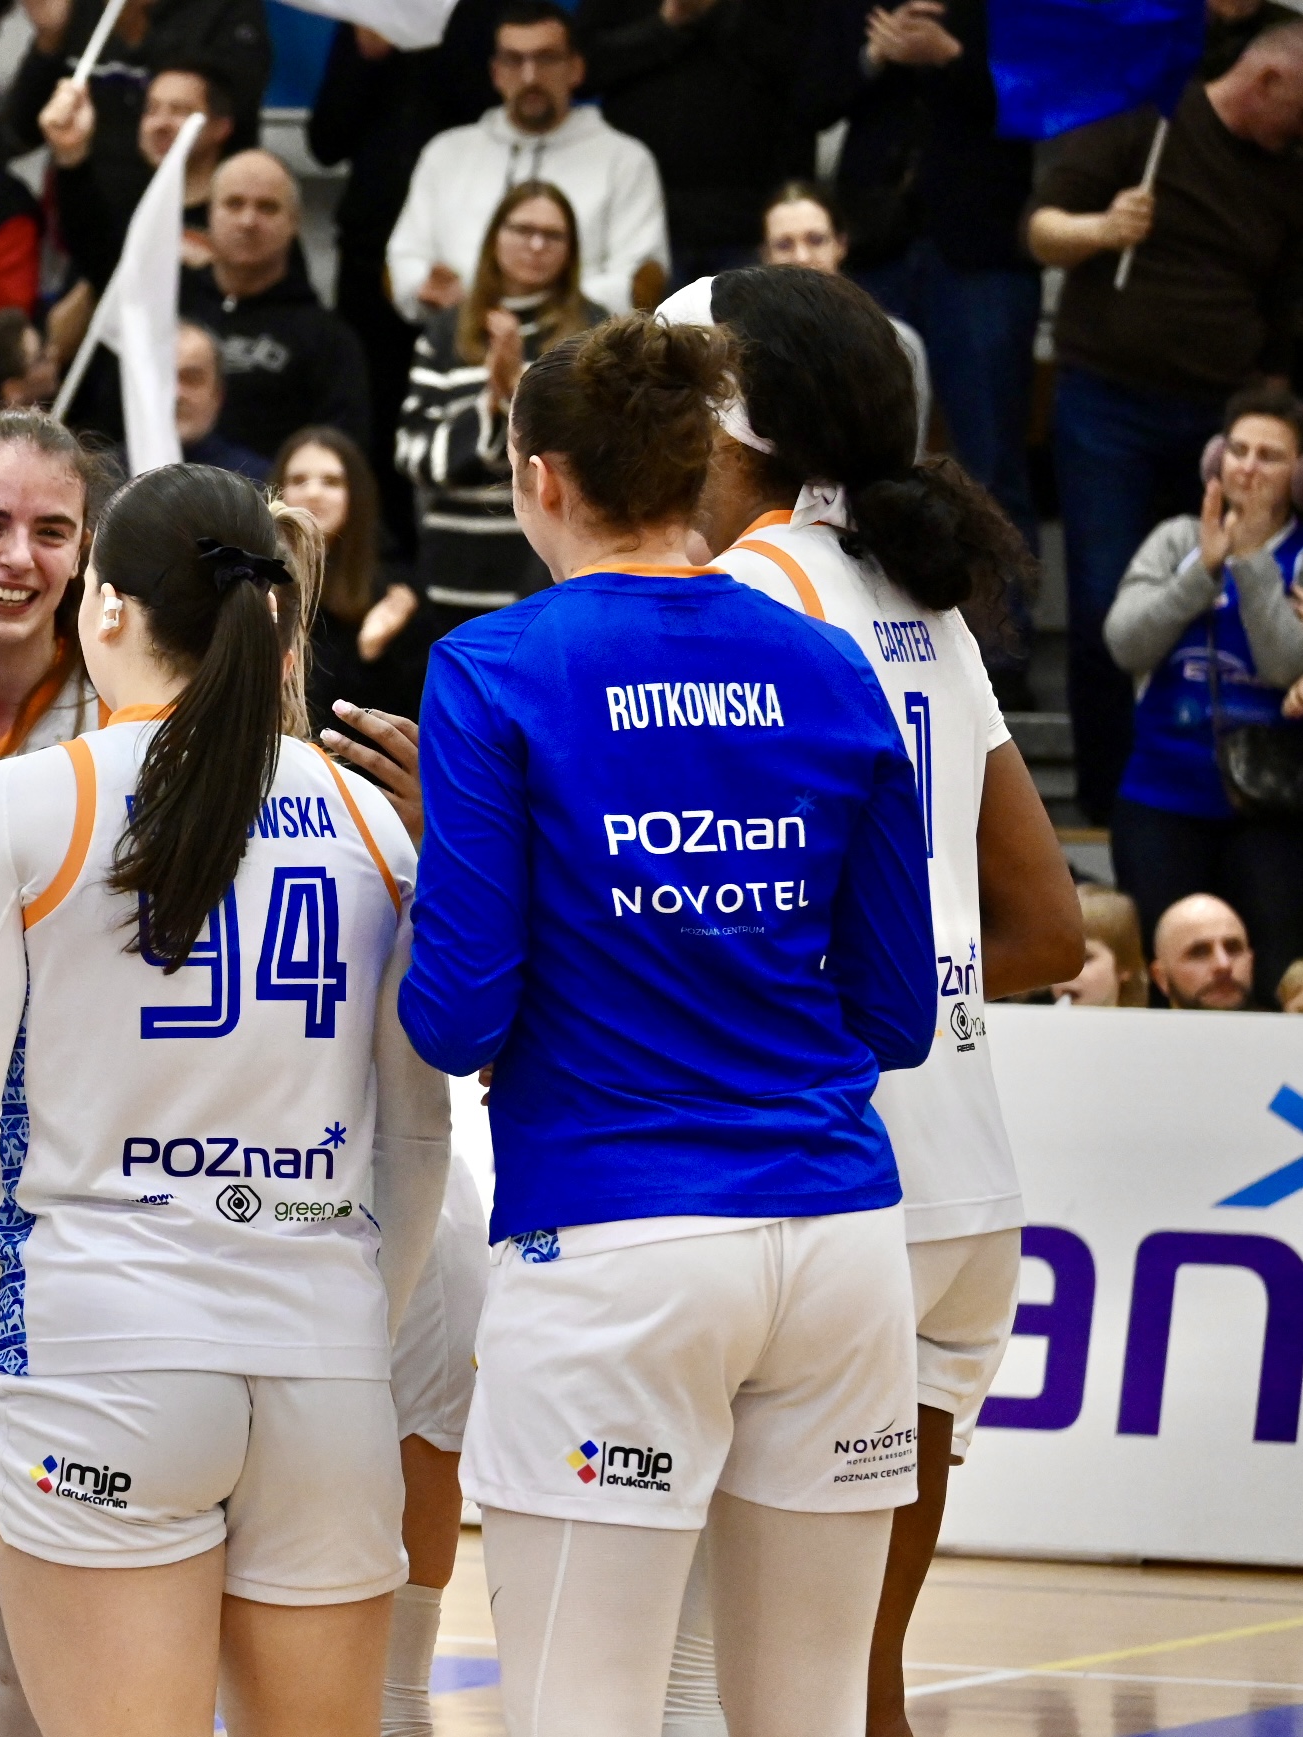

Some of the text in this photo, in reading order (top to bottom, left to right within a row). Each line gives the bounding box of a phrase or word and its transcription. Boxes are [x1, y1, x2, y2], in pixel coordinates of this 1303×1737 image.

[872, 620, 937, 662] CARTER
[605, 681, 785, 731] RUTKOWSKA
[611, 880, 809, 917] NOVOTEL
[137, 866, 347, 1039] 94
[274, 1201, 335, 1221] green
[834, 1428, 917, 1454] NOVOTEL
[846, 1456, 877, 1466] HOTELS
[885, 1448, 913, 1460] RESORTS
[65, 1462, 132, 1498] mjp
[608, 1446, 673, 1480] mjp
[61, 1488, 128, 1509] drukarnia
[606, 1474, 671, 1492] drukarnia
